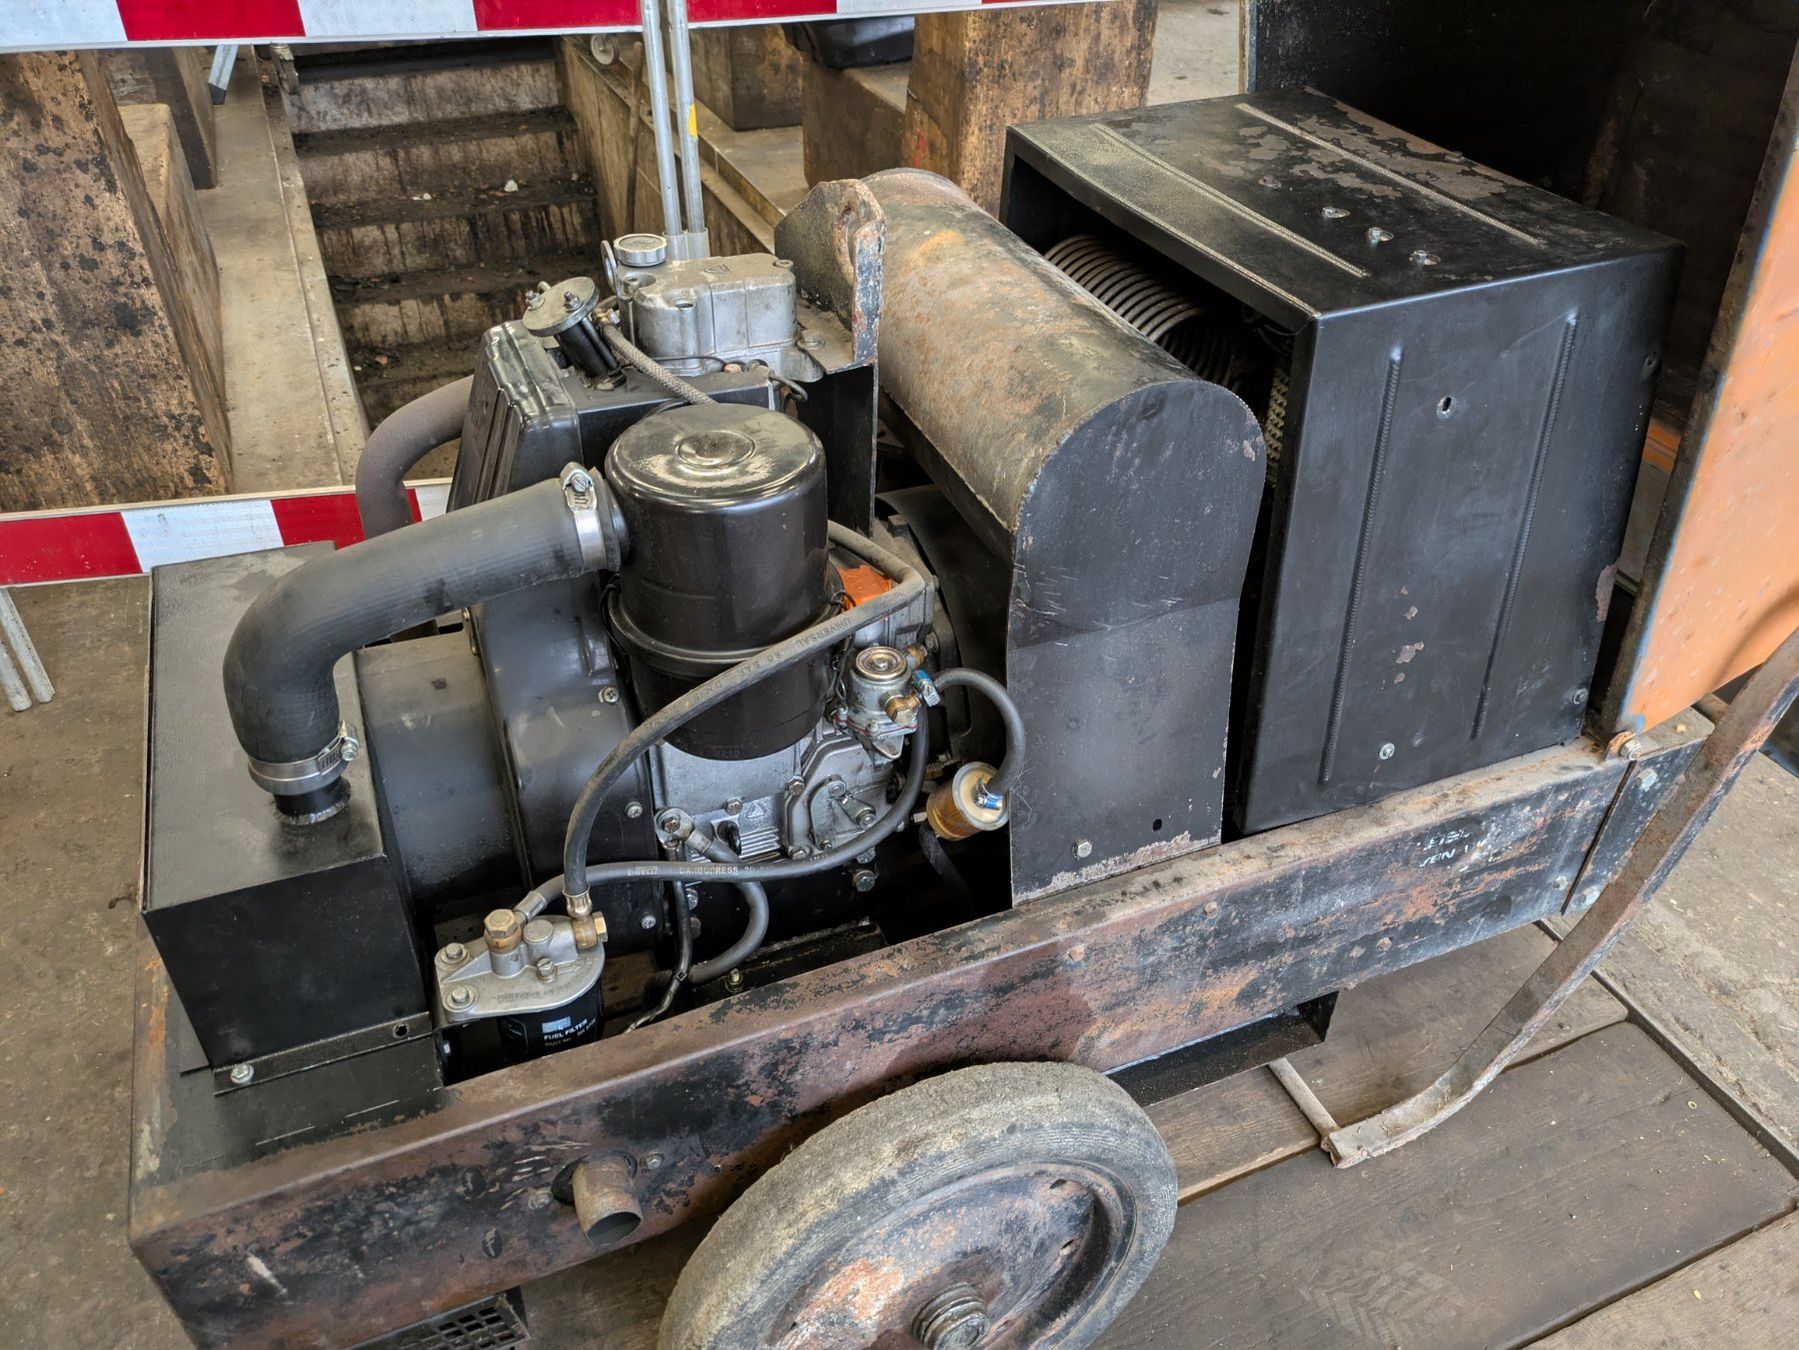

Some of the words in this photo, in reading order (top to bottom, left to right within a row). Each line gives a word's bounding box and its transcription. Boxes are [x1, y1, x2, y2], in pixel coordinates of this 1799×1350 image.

[795, 616, 852, 649] UNIVERSAL
[543, 1031, 565, 1040] FUEL
[565, 1018, 588, 1035] FILTER
